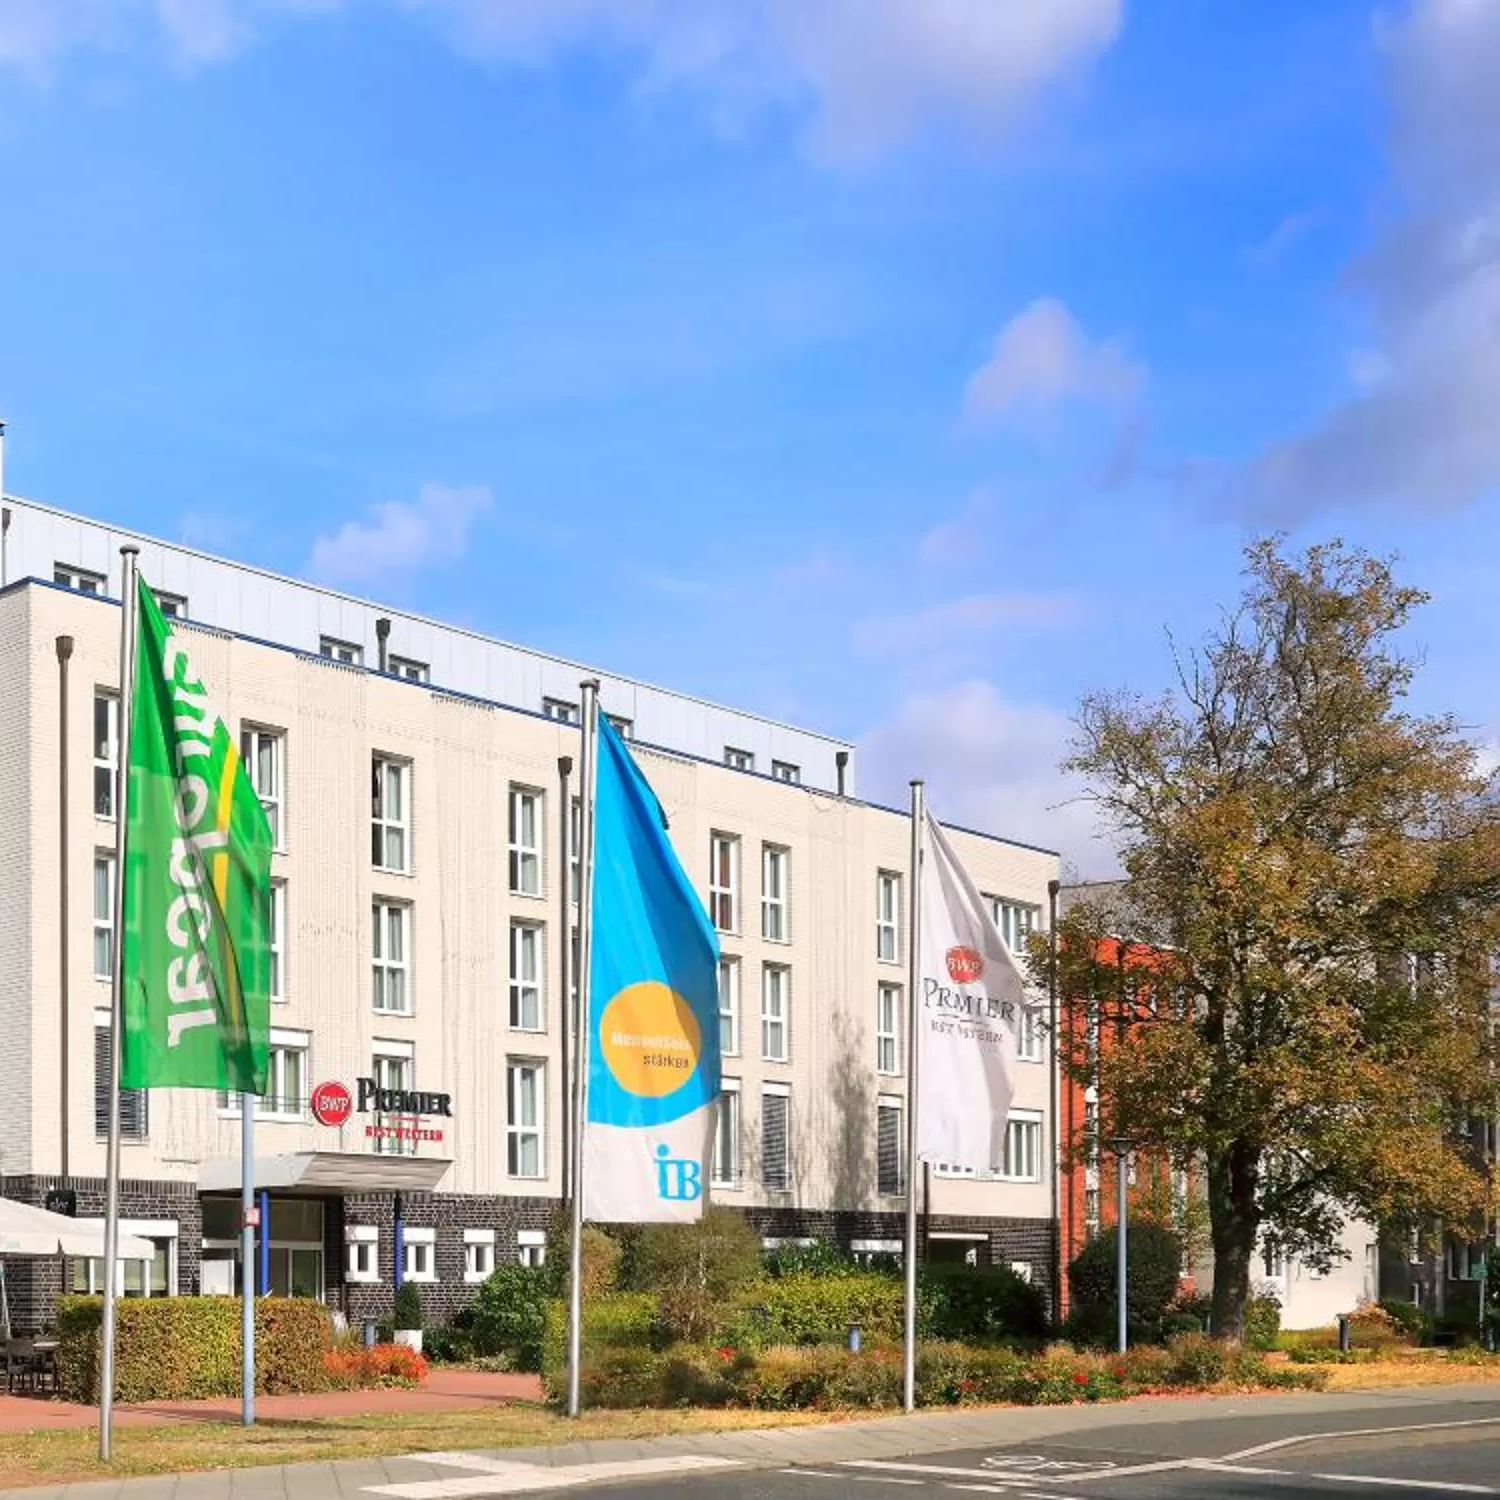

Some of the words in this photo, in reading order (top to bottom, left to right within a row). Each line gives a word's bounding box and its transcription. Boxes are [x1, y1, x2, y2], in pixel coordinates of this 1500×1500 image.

[923, 977, 1016, 1022] PRMIER
[319, 1095, 349, 1112] BWP
[356, 1077, 452, 1118] PREMIER
[365, 1125, 391, 1139] BEST
[393, 1127, 444, 1142] WESTERN
